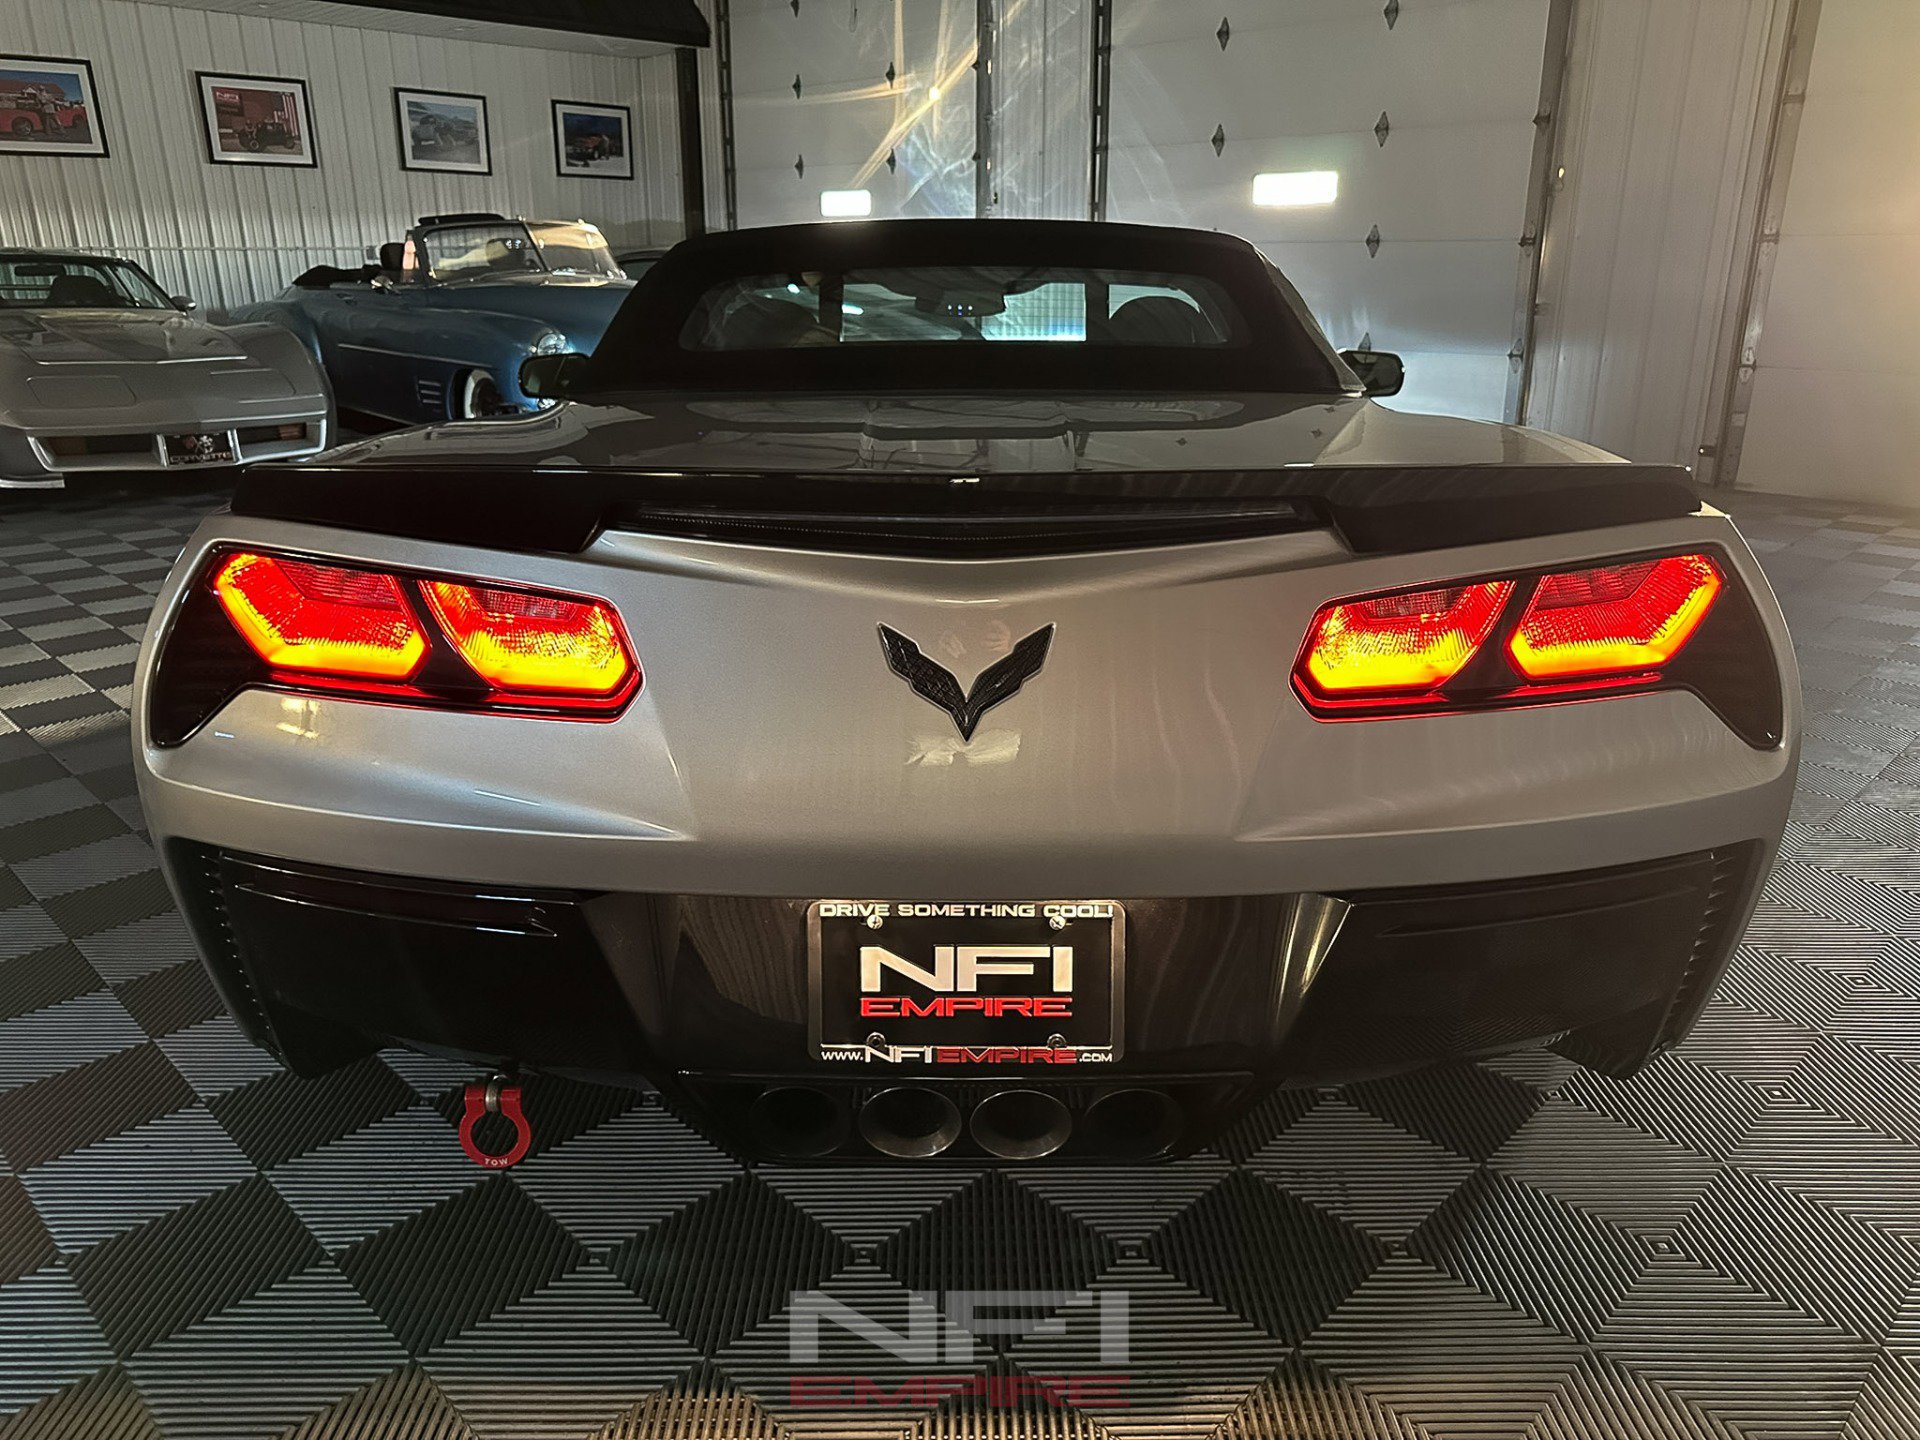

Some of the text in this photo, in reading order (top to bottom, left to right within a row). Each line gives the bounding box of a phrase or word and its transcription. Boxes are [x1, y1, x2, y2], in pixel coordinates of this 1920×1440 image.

[820, 904, 1113, 918] DRIVE SOMETHING COOL!
[860, 945, 1073, 992] NFI
[860, 997, 1073, 1017] EMPIRE
[484, 1158, 508, 1166] TOW
